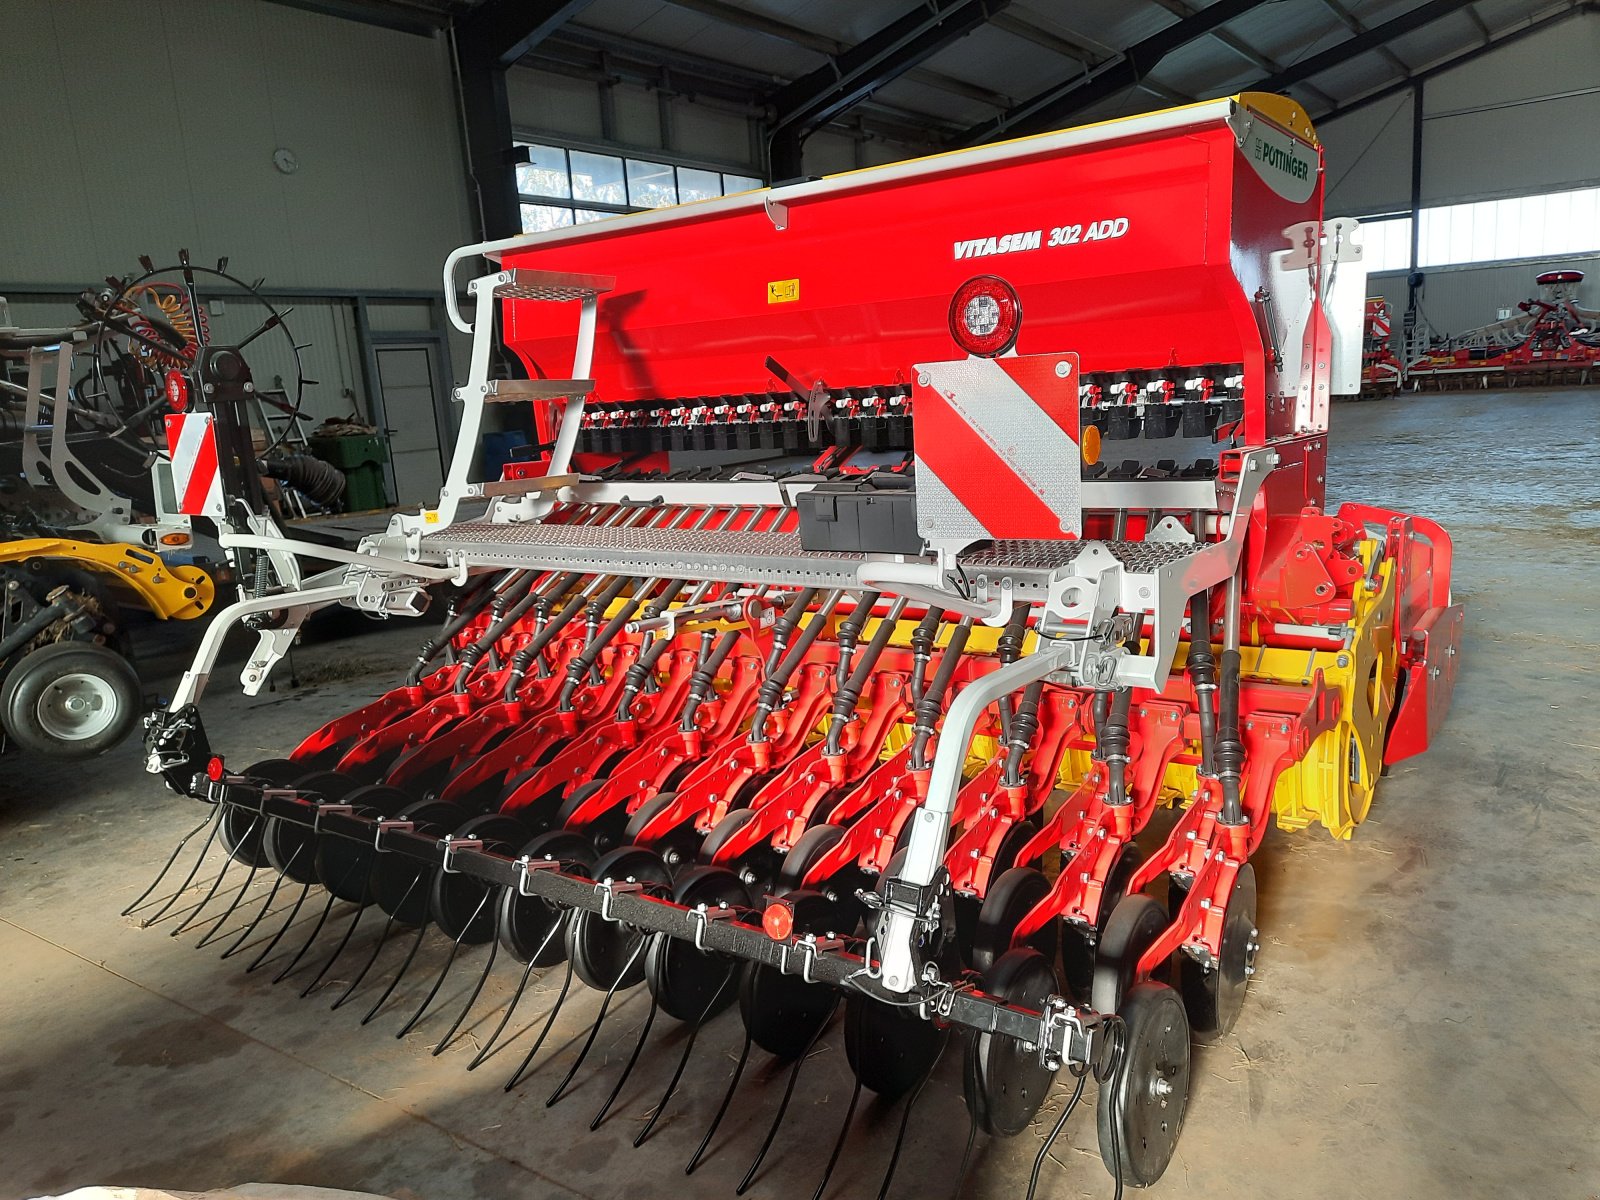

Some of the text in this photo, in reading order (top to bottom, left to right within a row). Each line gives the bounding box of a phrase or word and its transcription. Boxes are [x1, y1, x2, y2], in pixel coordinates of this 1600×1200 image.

[953, 217, 1129, 260] VITASEM 302 ADD
